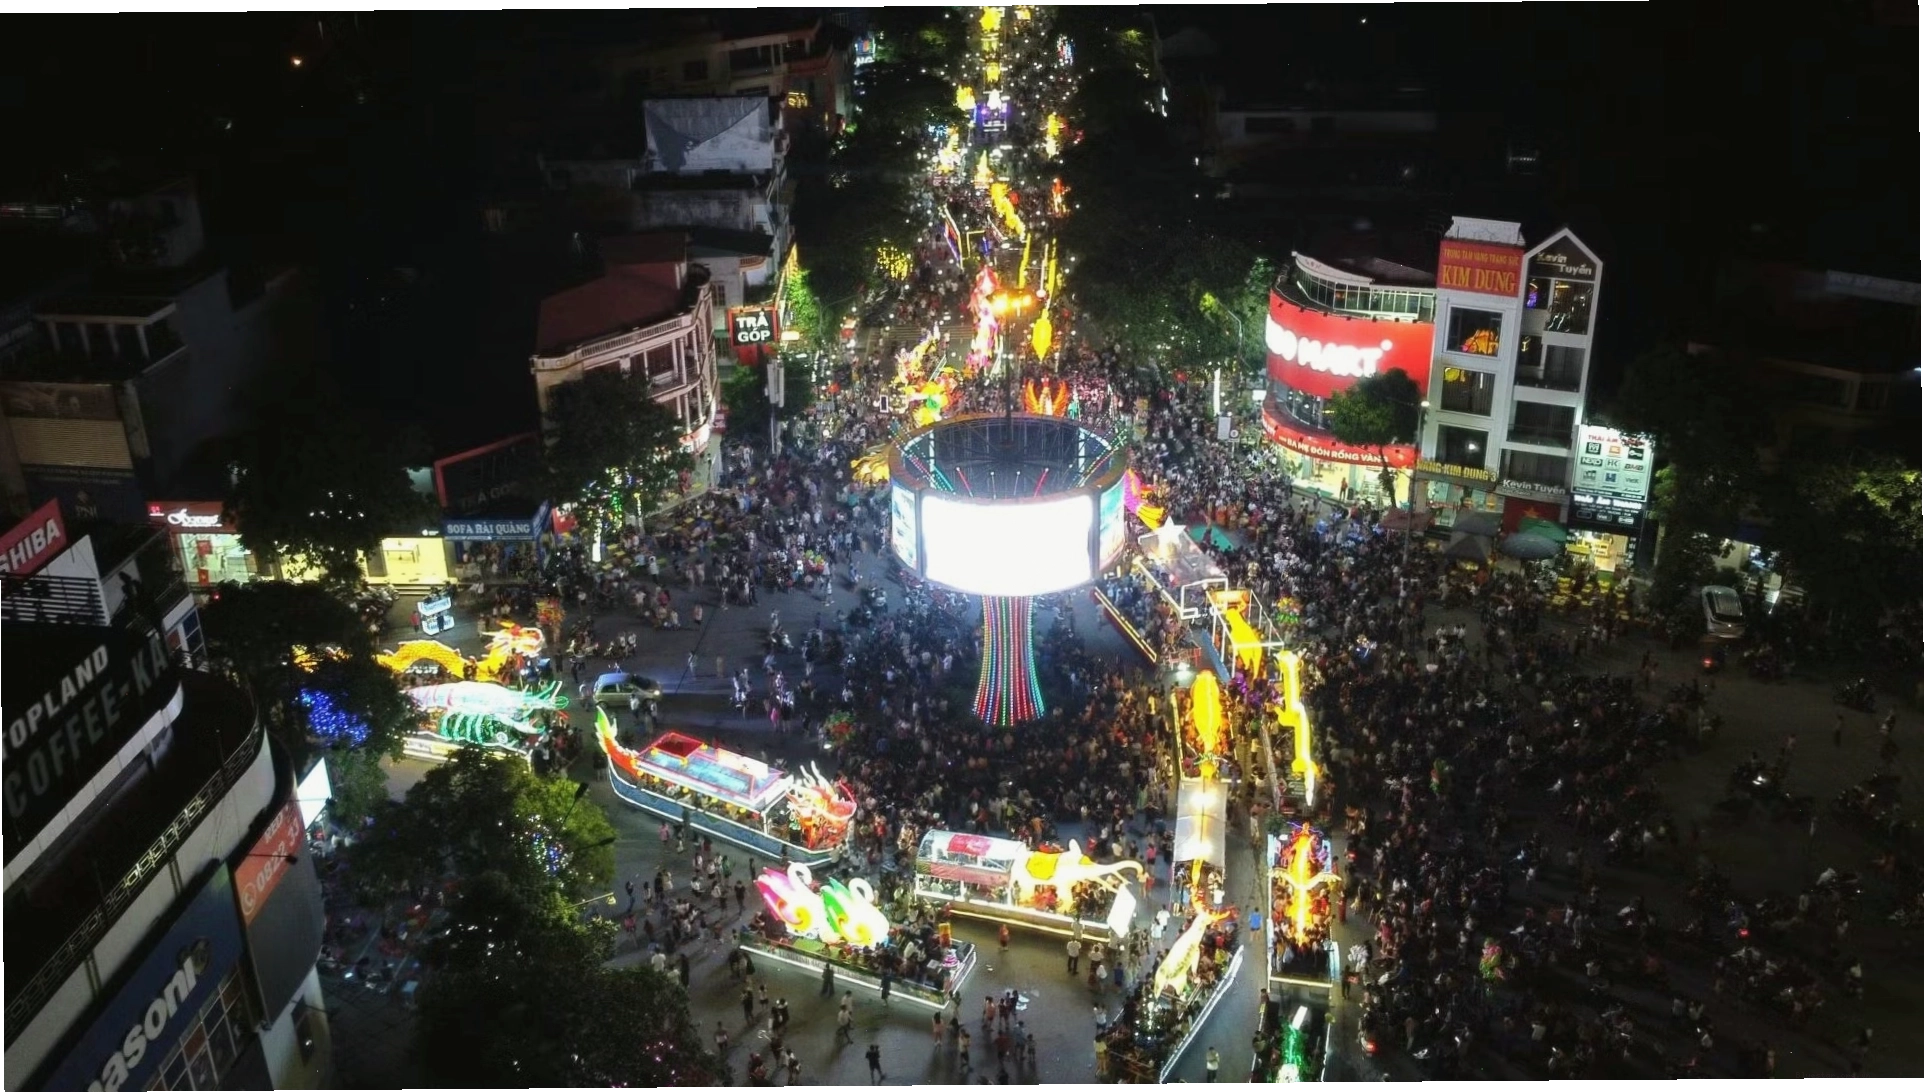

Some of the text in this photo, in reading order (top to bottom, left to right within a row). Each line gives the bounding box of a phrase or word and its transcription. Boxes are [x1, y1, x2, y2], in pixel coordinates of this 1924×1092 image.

[1536, 252, 1567, 264] Kevin
[1441, 265, 1518, 293] KIM DUNG
[736, 311, 769, 328] TRẢ
[737, 328, 771, 343] GÓP
[1287, 437, 1298, 449] BA
[1298, 441, 1310, 453] MẸ
[1310, 446, 1331, 457] ĐÓN
[1490, 472, 1497, 482] 3
[1503, 479, 1532, 490] Kevin
[446, 523, 474, 534] SOFA
